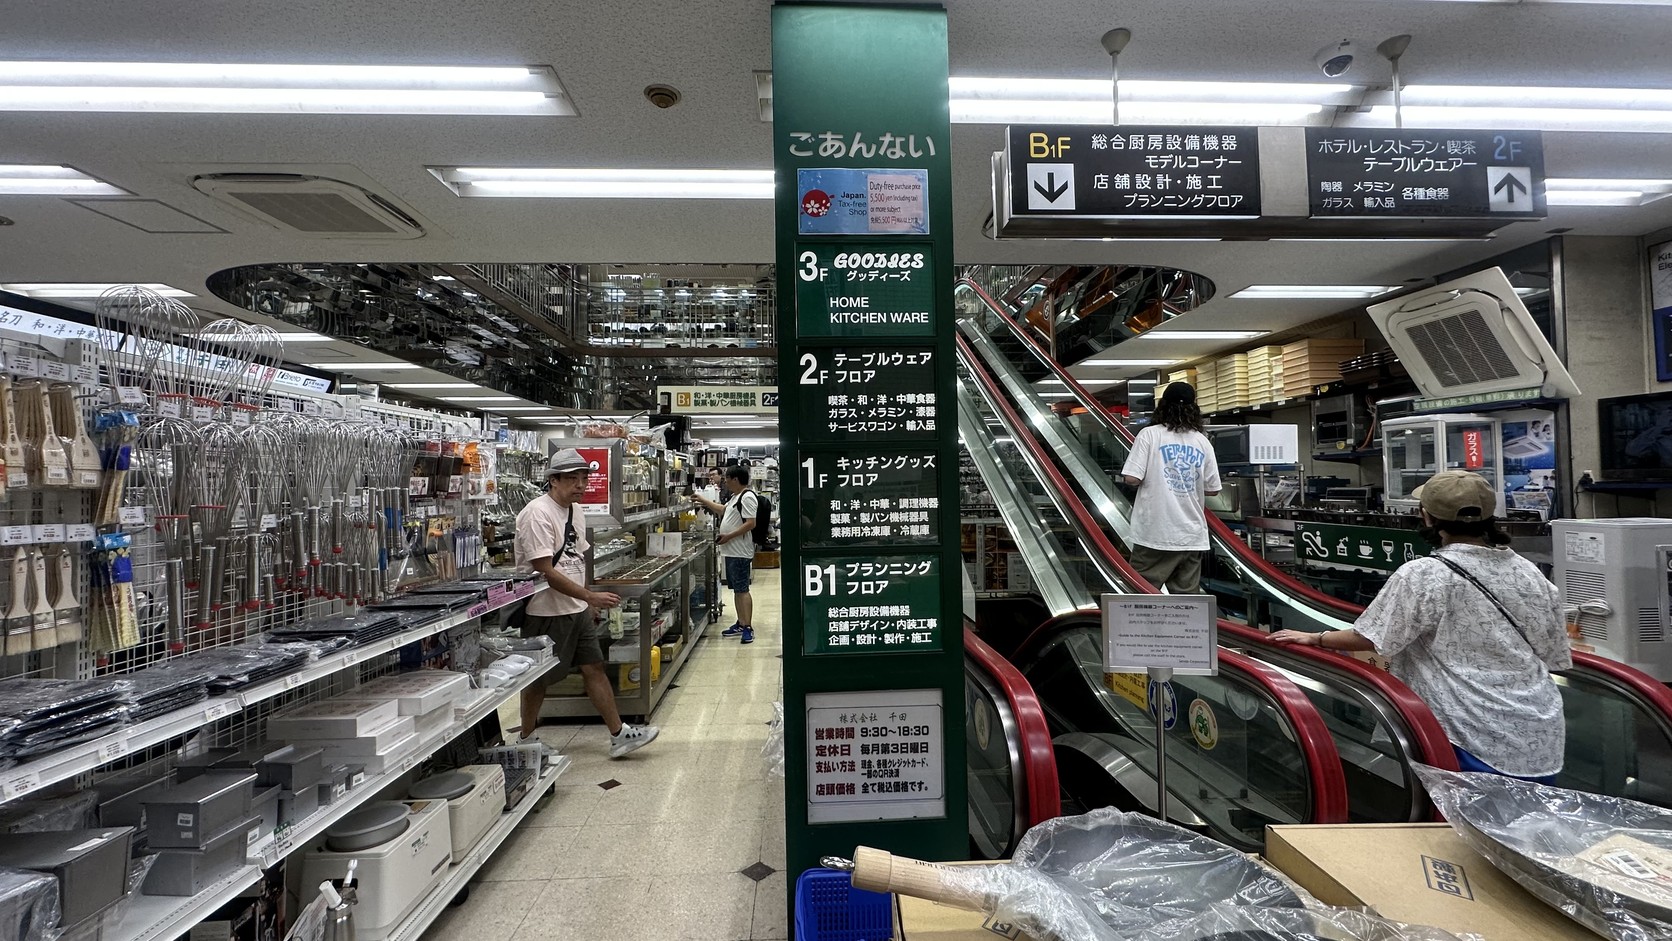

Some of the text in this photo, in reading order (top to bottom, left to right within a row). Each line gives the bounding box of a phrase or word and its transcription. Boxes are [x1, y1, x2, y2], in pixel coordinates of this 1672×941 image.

[789, 131, 936, 160] ごあんない
[1030, 132, 1071, 158] B1F
[1091, 133, 1238, 152] 総合厨房設備機器
[1318, 139, 1477, 155] ホテル・レストラン・喫茶
[1493, 136, 1522, 160] 2F
[1144, 154, 1242, 169] モデルコーナー
[1363, 156, 1478, 172] テーブルウェアー
[870, 181, 894, 191] Duty-free
[1092, 174, 1223, 190] 店舗設計・施工
[1321, 180, 1395, 193] 陶器 メラミン
[870, 193, 884, 202] 5,500
[1124, 193, 1243, 208] プランニングフロア
[1401, 187, 1449, 201] 各種食器
[838, 200, 866, 208] Tax-free
[1322, 196, 1395, 209] ガラス 輸入品
[849, 208, 867, 216] Shop
[799, 251, 924, 281] 3F GOODIES
[847, 270, 911, 282] グッディーズ
[830, 297, 869, 308] HOME
[830, 312, 929, 323] KITCHEN WARE
[834, 352, 932, 367] テーブルウェア
[799, 353, 829, 384] 2F
[835, 370, 876, 384] フロア
[678, 394, 690, 405] B1
[828, 393, 936, 405] 喫茶・和・洋・中華食器
[828, 406, 936, 418] ガラス・メラミン・漆器
[828, 419, 936, 431] サービスワゴン・輸入品
[1467, 433, 1479, 456] ガラス
[837, 455, 936, 470] キッチングッズ
[801, 458, 828, 488] 1F
[837, 474, 879, 487] フロア
[830, 498, 939, 511] 和・洋・中華・調理機器
[830, 512, 929, 524] 製菓・製パン機械器具
[831, 525, 930, 538] 業務用冷凍庫・冷蔵庫
[846, 561, 932, 577] プランニング
[805, 564, 837, 597] B1
[846, 580, 889, 594] フロア
[828, 605, 910, 618] 総合厨房設備機器
[828, 619, 937, 632] 店舗デザイン・内装工事
[828, 633, 932, 646] 企画・設計・製作・施工
[839, 712, 907, 723] 株式会社 千田
[815, 727, 855, 740] 営業時間
[815, 742, 929, 757] 定休日 毎月第3日曜日
[815, 760, 856, 773] 支払い方法
[815, 780, 928, 796] 店頭価格 全て税込価格です。
